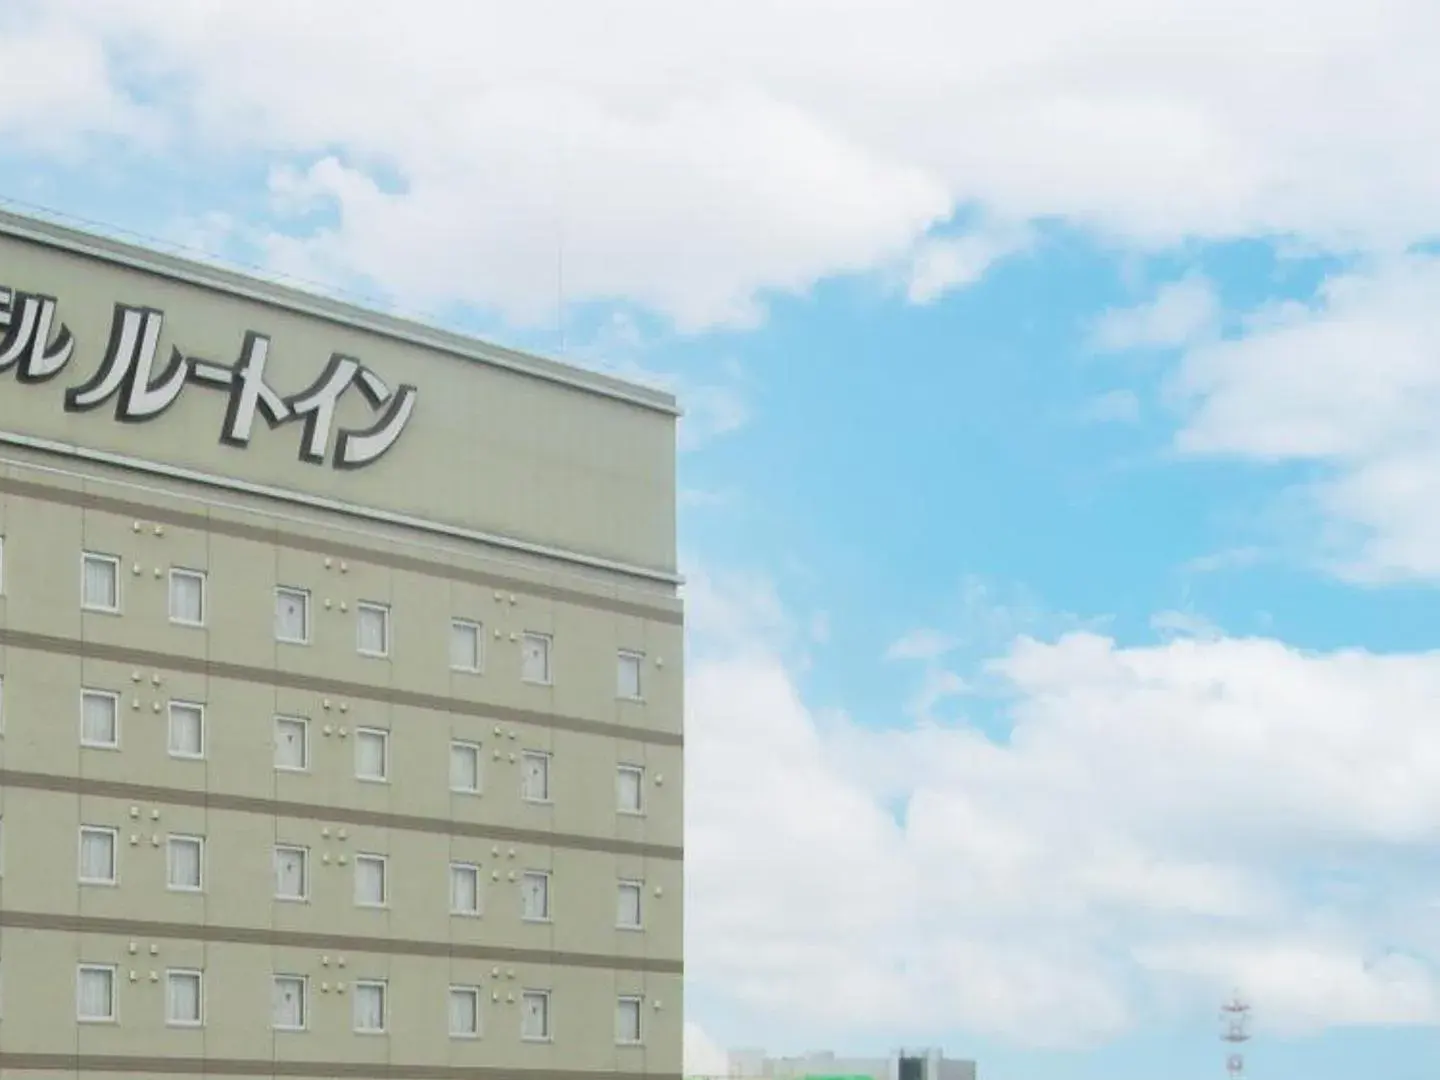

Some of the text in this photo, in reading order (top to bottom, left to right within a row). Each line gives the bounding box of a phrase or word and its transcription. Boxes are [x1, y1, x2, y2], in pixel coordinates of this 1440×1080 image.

[64, 302, 418, 470] ルートイン
